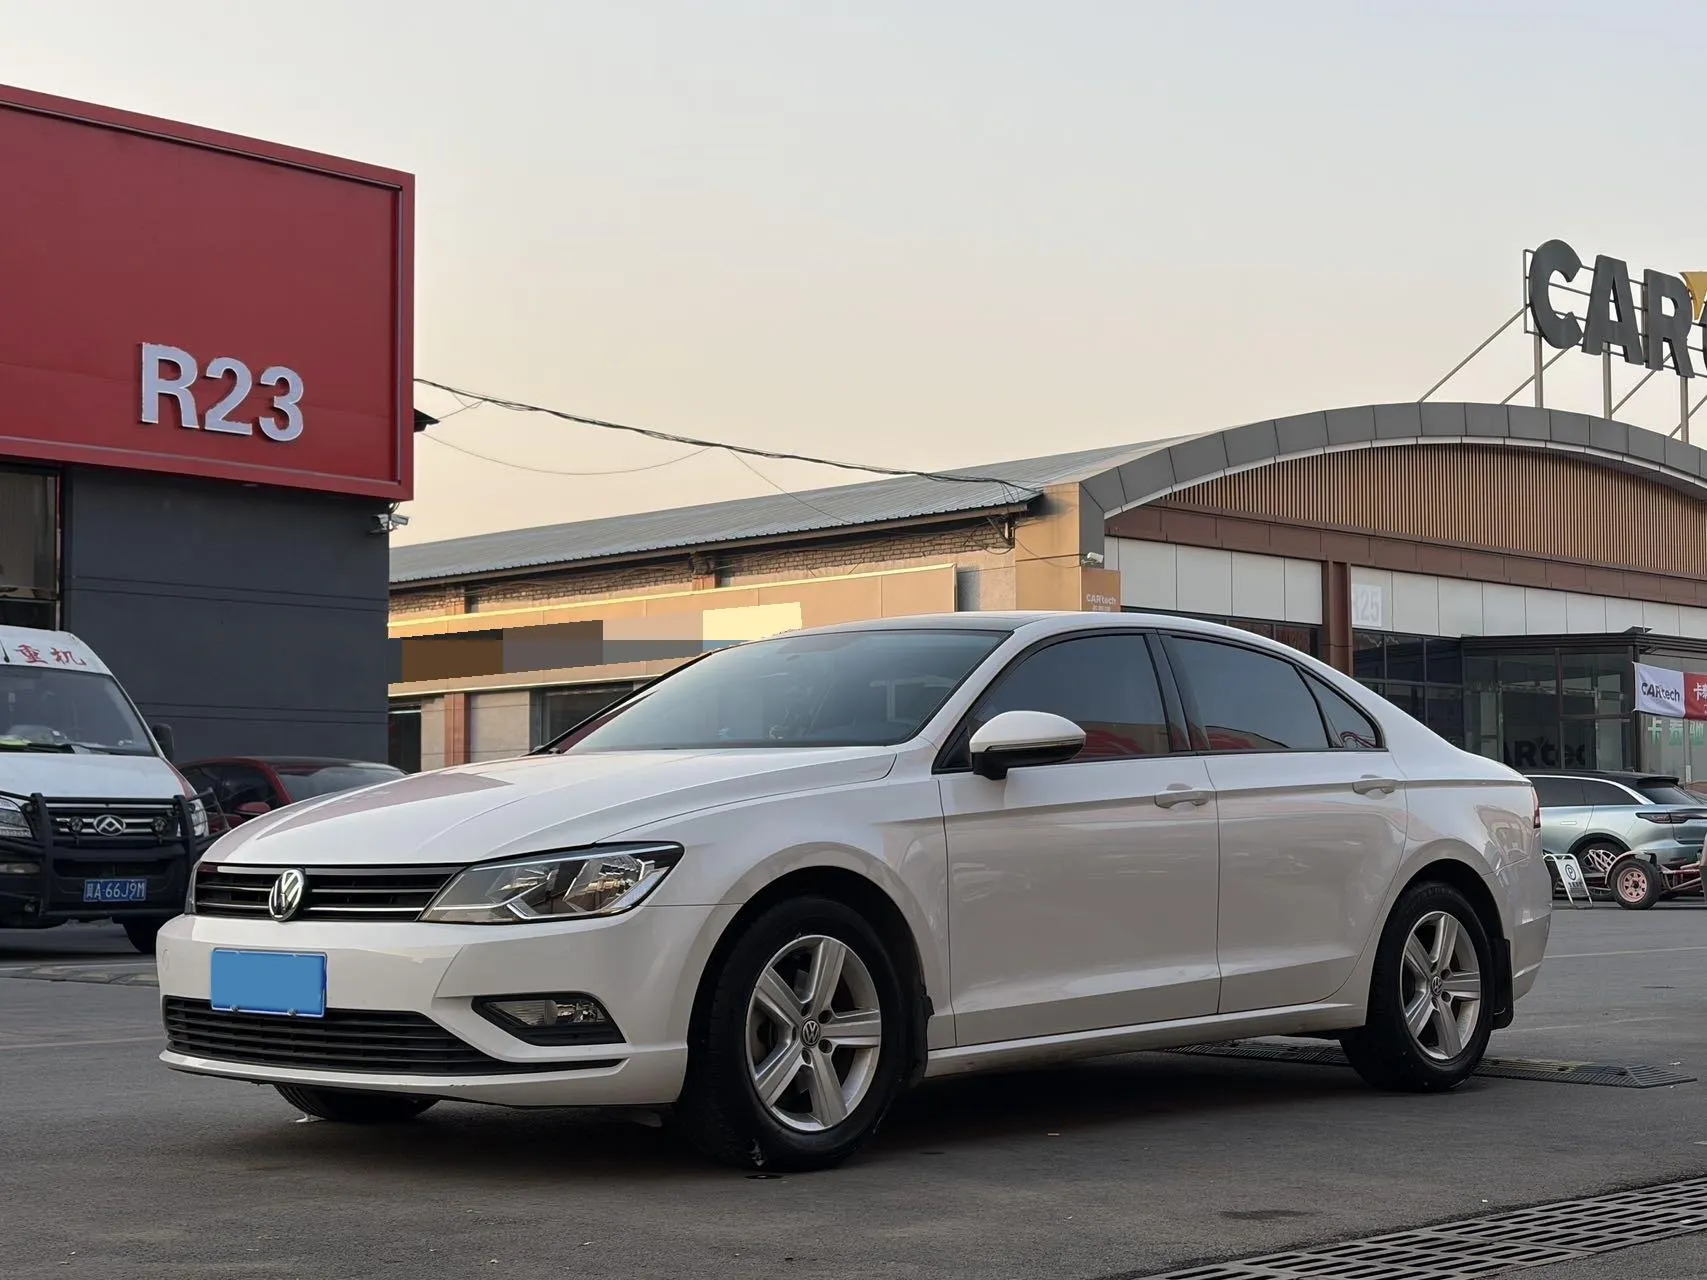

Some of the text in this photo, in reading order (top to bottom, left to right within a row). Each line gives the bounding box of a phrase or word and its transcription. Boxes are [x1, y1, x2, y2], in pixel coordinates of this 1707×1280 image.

[1529, 239, 1707, 379] CAR
[141, 341, 304, 442] R23
[1641, 682, 1680, 703] CARtech
[1693, 682, 1707, 703] 卡
